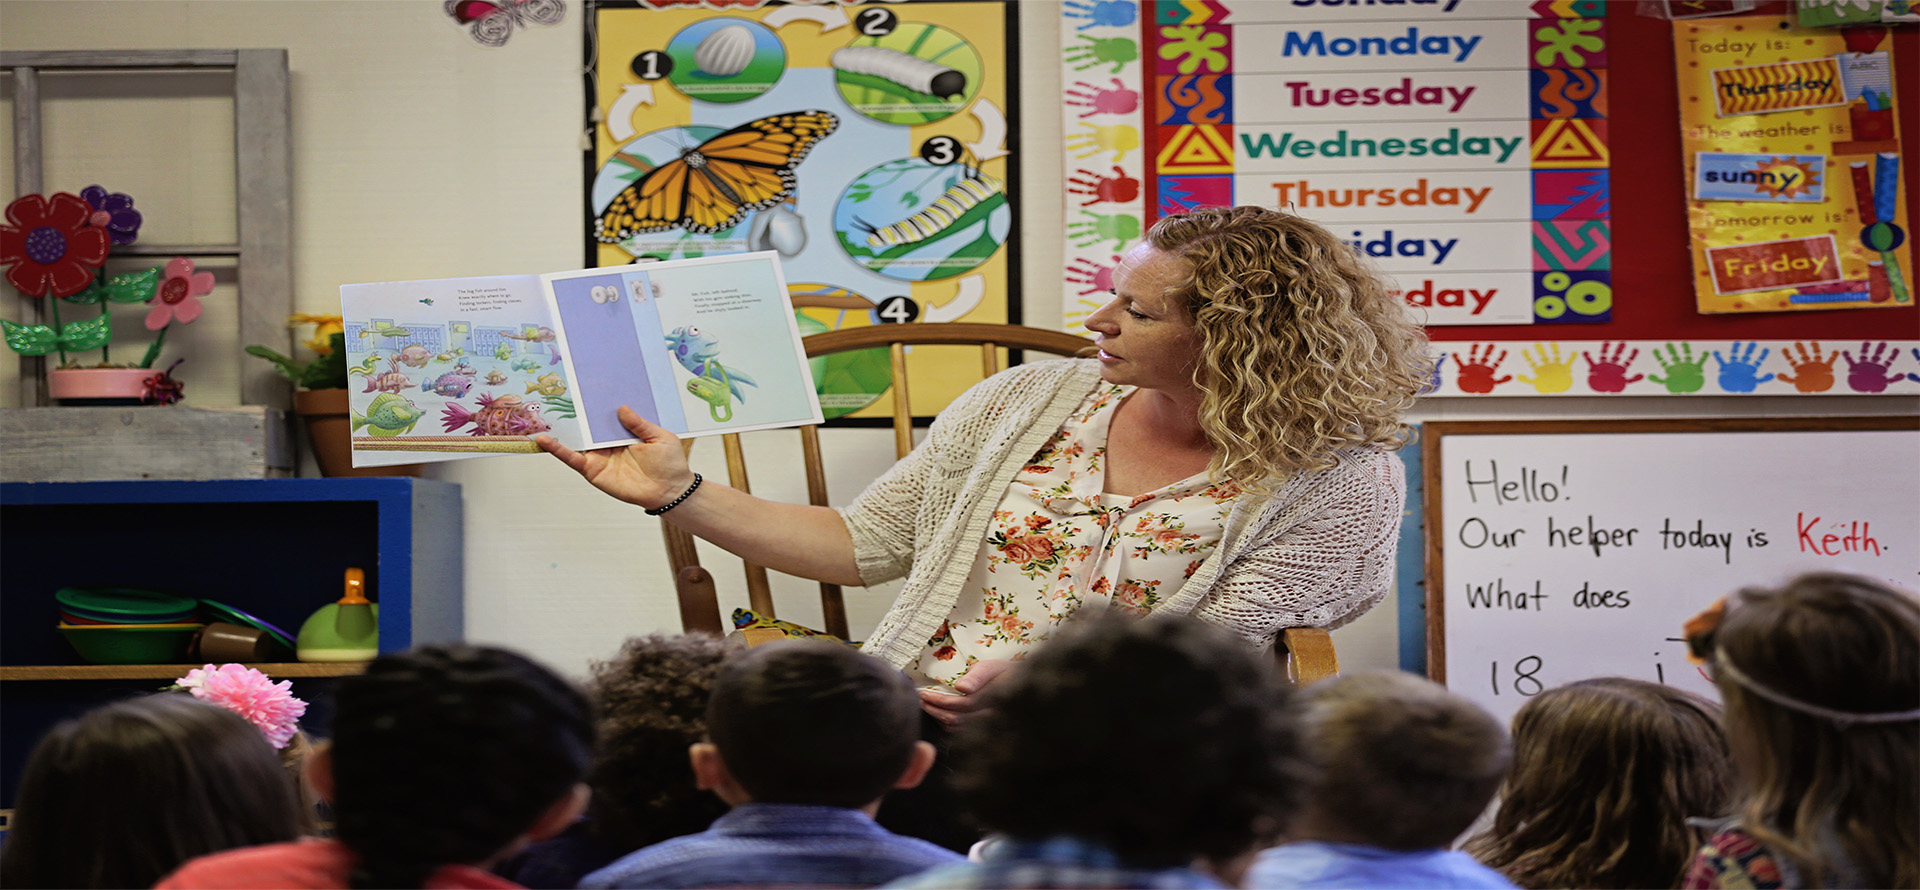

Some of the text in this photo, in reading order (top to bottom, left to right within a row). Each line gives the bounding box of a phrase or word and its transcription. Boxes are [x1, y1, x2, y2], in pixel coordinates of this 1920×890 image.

[864, 9, 890, 35] 2
[1282, 26, 1483, 62] Monday
[1688, 38, 1757, 57] Today
[643, 53, 661, 78] 1
[1284, 78, 1476, 113] Tuesday
[1721, 76, 1834, 98] Thursday
[1697, 124, 1731, 139] The
[1738, 122, 1821, 138] weather
[928, 137, 954, 165] 3
[1240, 128, 1524, 163] Wednesday
[1705, 170, 1798, 192] sunny
[1271, 178, 1492, 214] Thursday
[1703, 211, 1814, 227] Tomorrow
[1343, 230, 1458, 265] iday
[1724, 253, 1828, 277] Friday
[880, 298, 911, 323] 4
[1466, 459, 1570, 505] Hello!
[1459, 512, 1888, 565] Our helper today is Keith.
[1466, 578, 1631, 612] What does
[1491, 655, 1544, 697] 18
